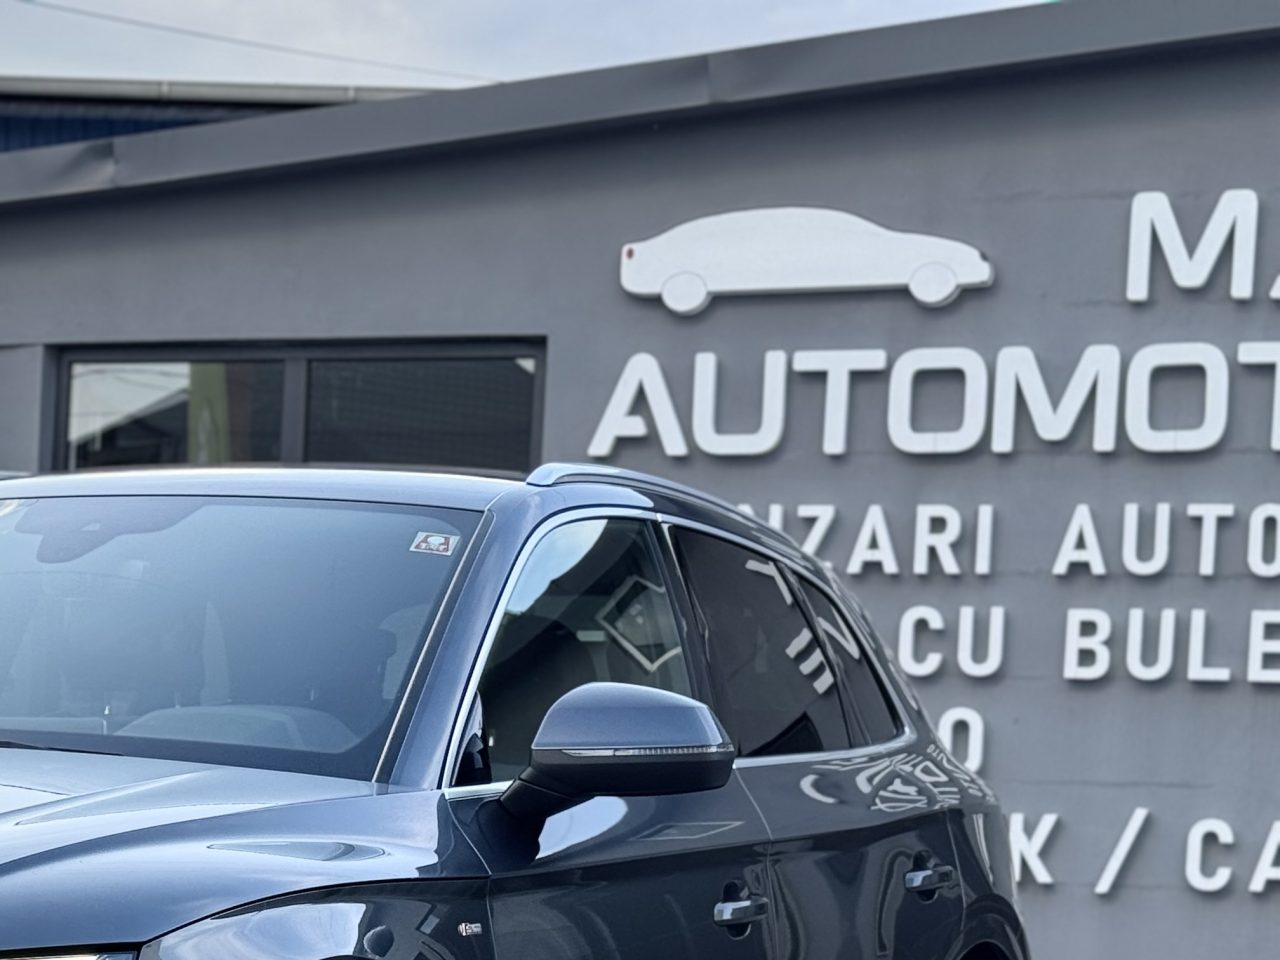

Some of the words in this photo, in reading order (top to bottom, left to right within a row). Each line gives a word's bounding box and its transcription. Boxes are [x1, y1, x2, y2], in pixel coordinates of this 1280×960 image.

[1126, 187, 1280, 299] M
[1052, 502, 1280, 578] AUTO
[899, 605, 1006, 679] CU
[1063, 609, 1280, 684] BULE
